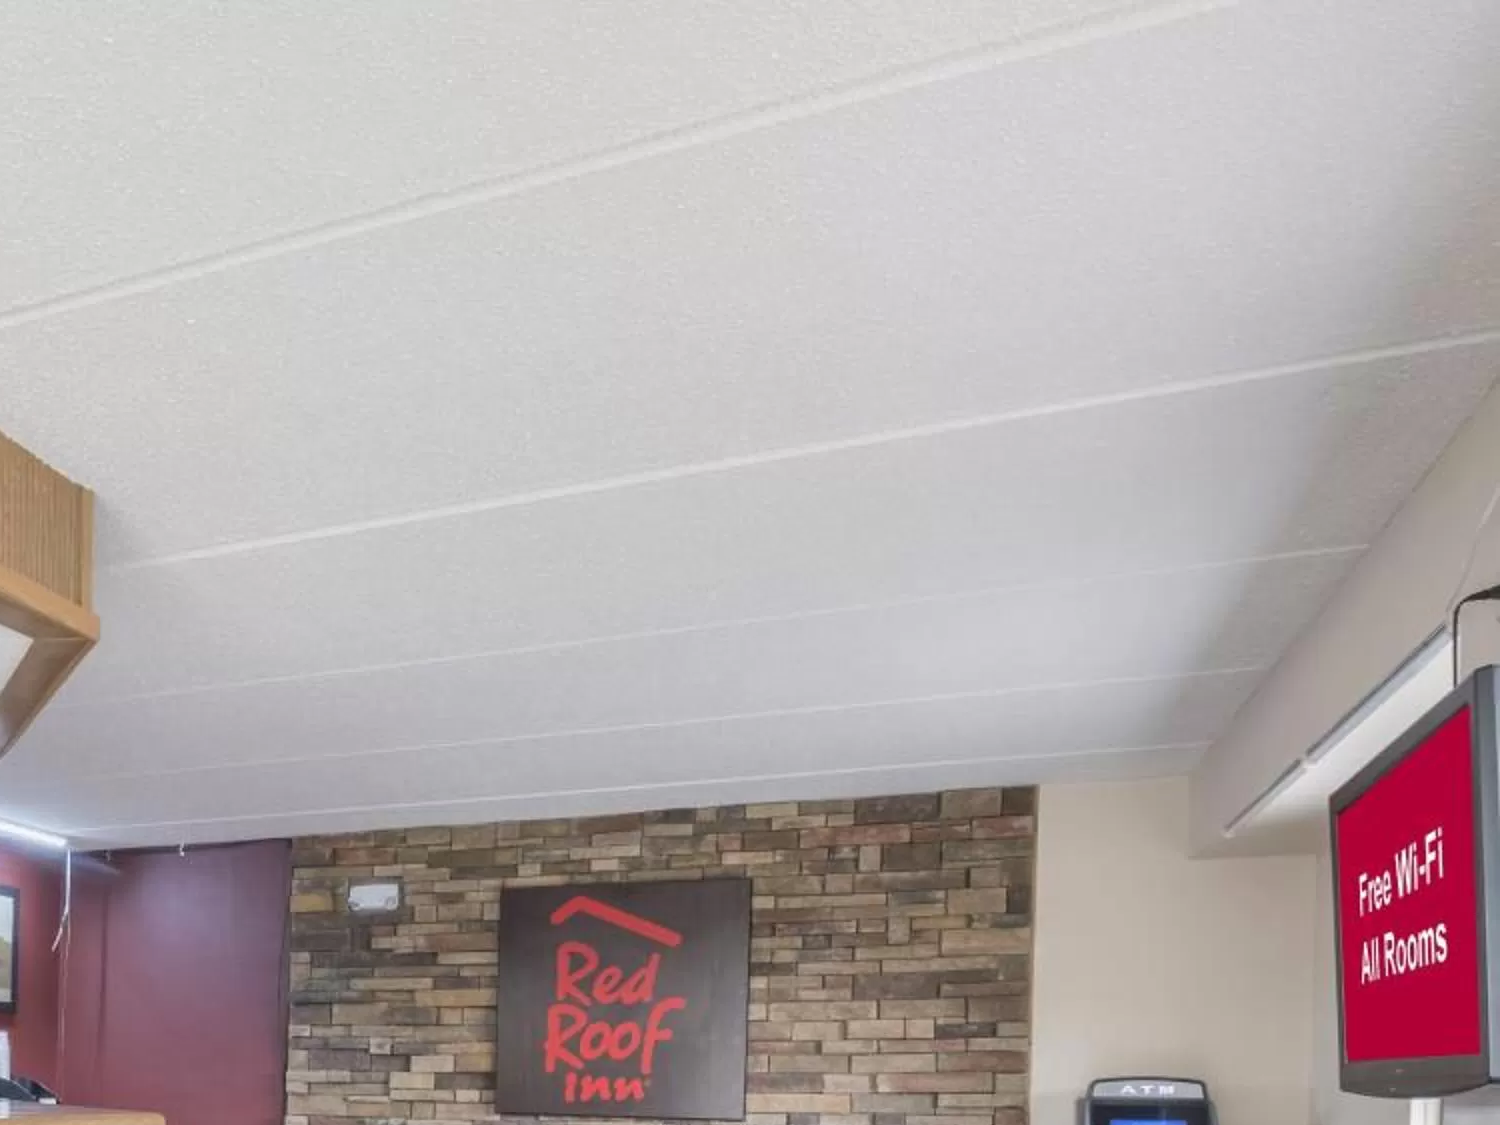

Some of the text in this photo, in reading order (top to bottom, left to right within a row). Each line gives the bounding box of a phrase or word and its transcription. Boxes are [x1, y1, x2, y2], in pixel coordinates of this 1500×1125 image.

[1358, 826, 1445, 918] Free Wi-Fi
[555, 940, 662, 1007] Red
[1361, 922, 1449, 985] All Rooms
[543, 996, 688, 1075] Roof
[1120, 1084, 1176, 1096] ATM
